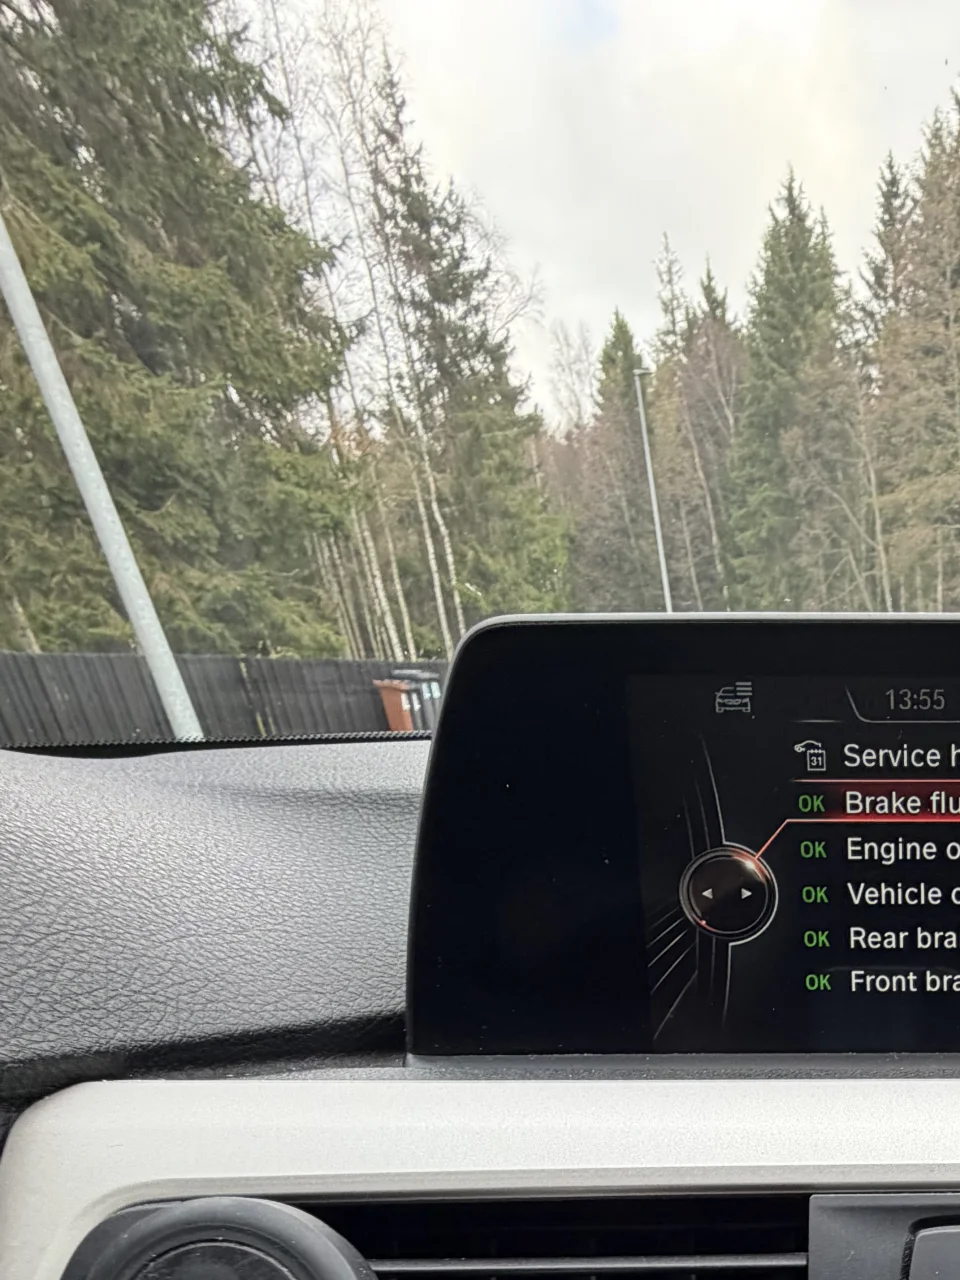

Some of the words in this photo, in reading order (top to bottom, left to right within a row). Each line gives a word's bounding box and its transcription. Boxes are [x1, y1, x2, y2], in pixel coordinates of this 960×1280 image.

[885, 688, 945, 710] 13:55
[843, 743, 941, 768] Service
[798, 794, 825, 813] OK
[845, 790, 922, 814] Brake
[800, 840, 827, 859] OK
[847, 837, 937, 866] Engine
[802, 886, 829, 903] OK
[847, 882, 942, 905] Vehicle
[803, 930, 830, 948] OK
[849, 926, 909, 949] Rear
[805, 974, 832, 991] OK
[851, 970, 918, 992] Front
